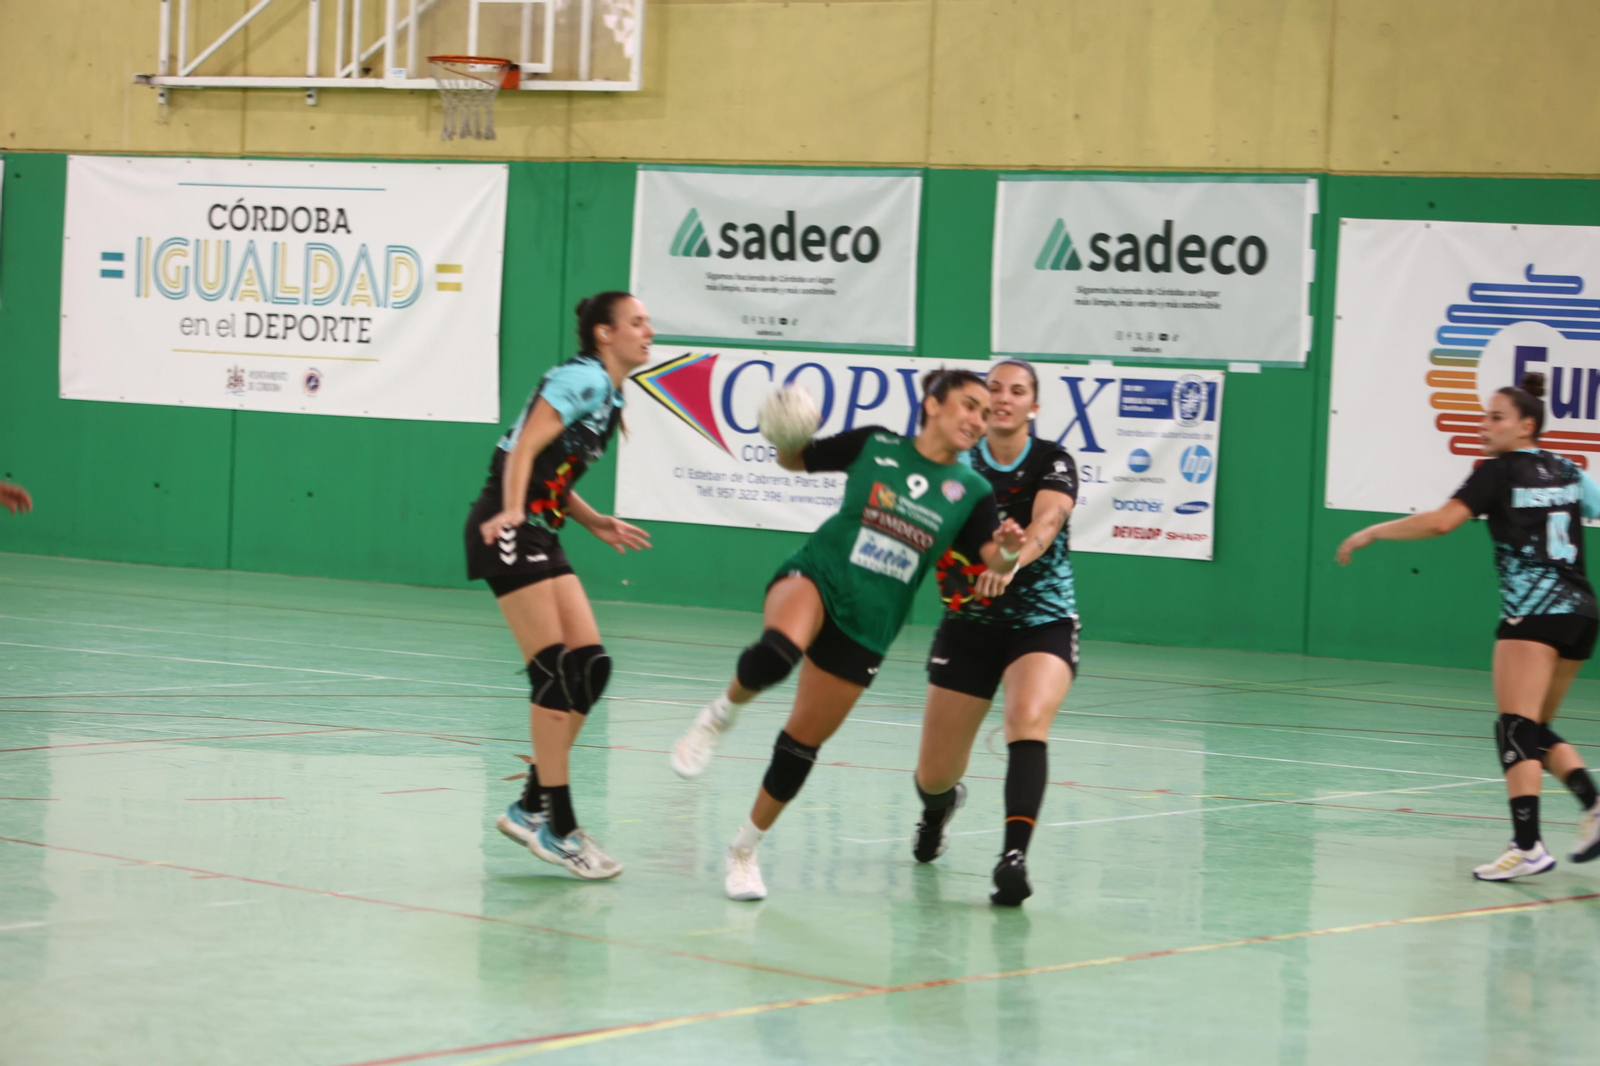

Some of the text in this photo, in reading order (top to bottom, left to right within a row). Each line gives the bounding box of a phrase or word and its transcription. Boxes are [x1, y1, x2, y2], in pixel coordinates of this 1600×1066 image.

[208, 198, 352, 234] CÓRDOBA
[716, 210, 881, 263] sadeco
[1088, 219, 1268, 276] sadeco
[135, 237, 424, 309] IGUALDAD
[180, 312, 372, 344] en el DEPORTE
[730, 472, 743, 484] de
[906, 473, 930, 500] 9
[1112, 498, 1164, 513] brother
[1112, 525, 1209, 542] DEVELOP SHARP
